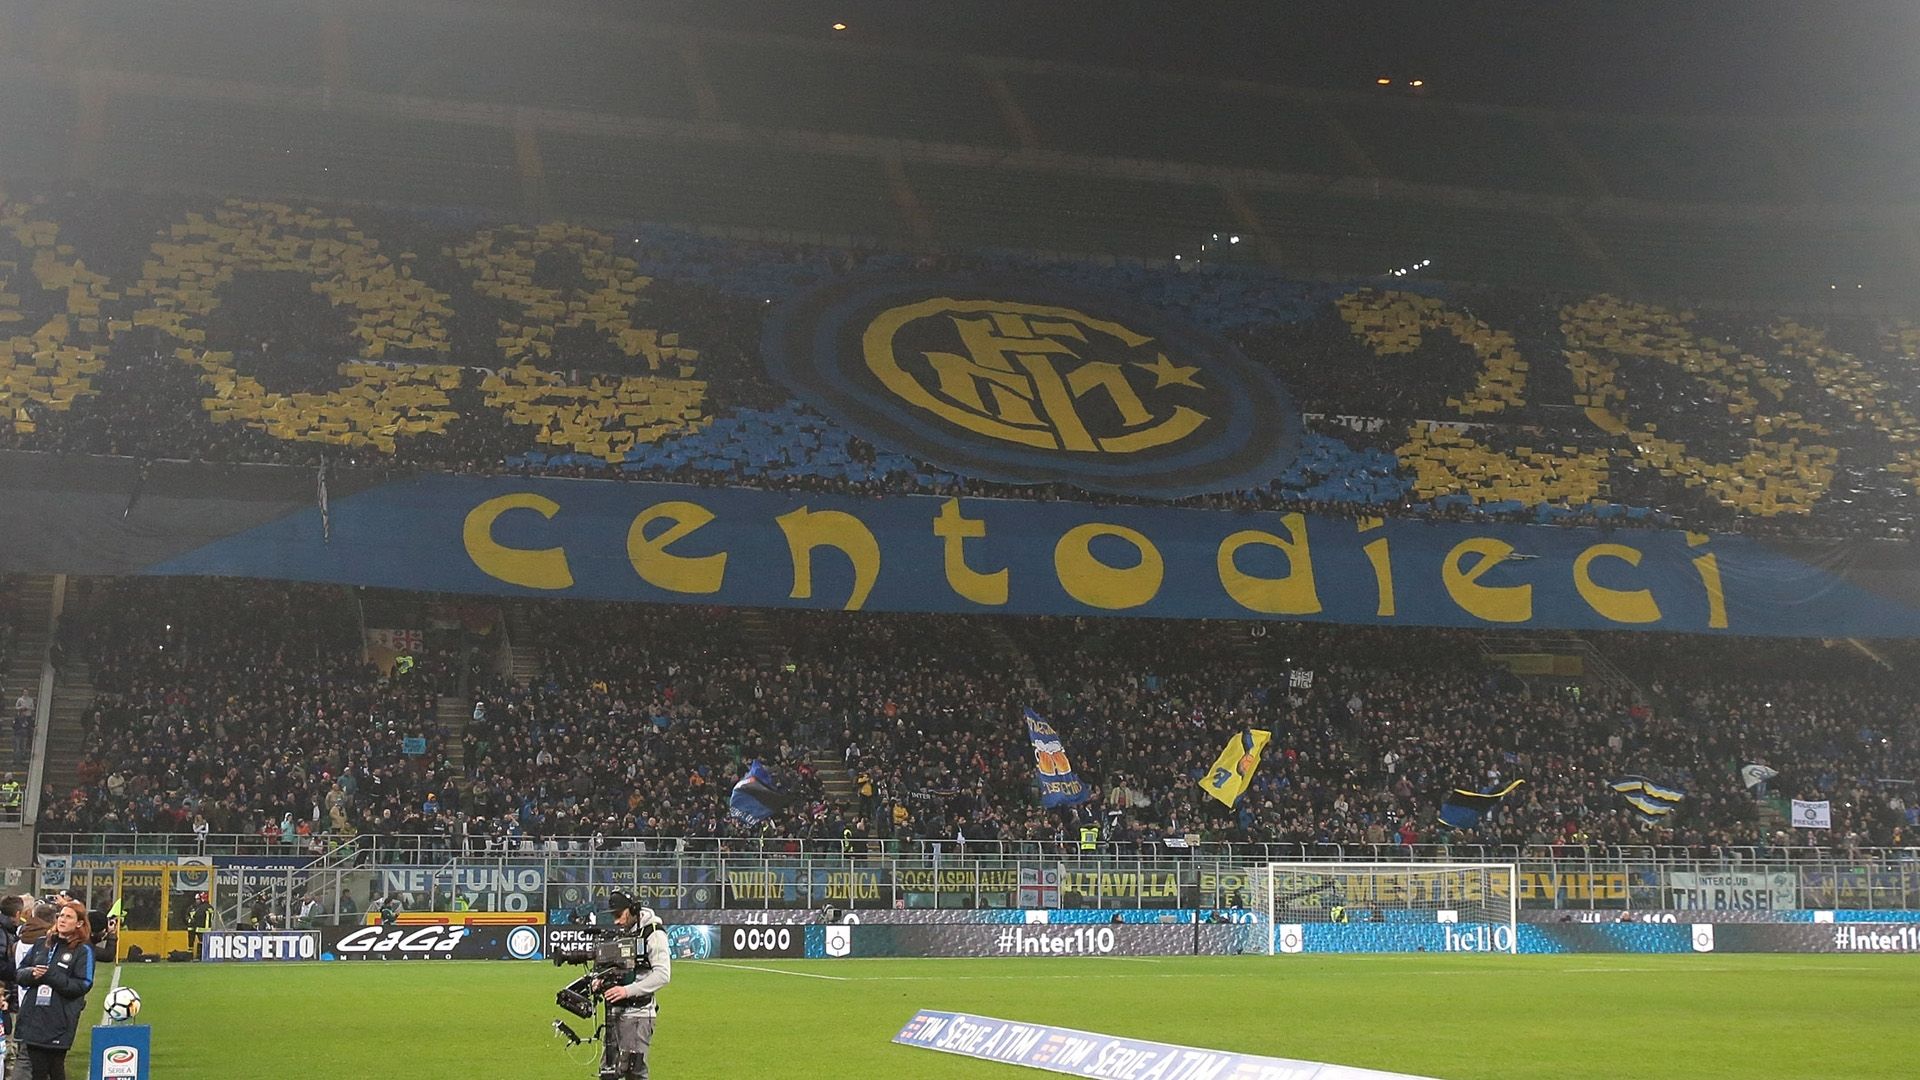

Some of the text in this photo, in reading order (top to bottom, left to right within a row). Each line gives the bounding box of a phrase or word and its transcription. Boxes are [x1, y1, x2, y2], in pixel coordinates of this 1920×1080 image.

[463, 493, 1728, 630] centodieci
[825, 872, 880, 899] BERICA
[1062, 872, 1178, 897] ALTAVILLA
[210, 936, 314, 959] RISPETTO
[733, 928, 791, 951] 00:00
[998, 928, 1115, 953] #Inter110
[1836, 927, 1920, 950] #Inter11
[913, 1017, 949, 1042] TIM
[936, 1016, 993, 1053] SERIE
[993, 1026, 1046, 1061] TIM
[1051, 1037, 1098, 1067] TIM
[1083, 1040, 1157, 1080] SERIE
